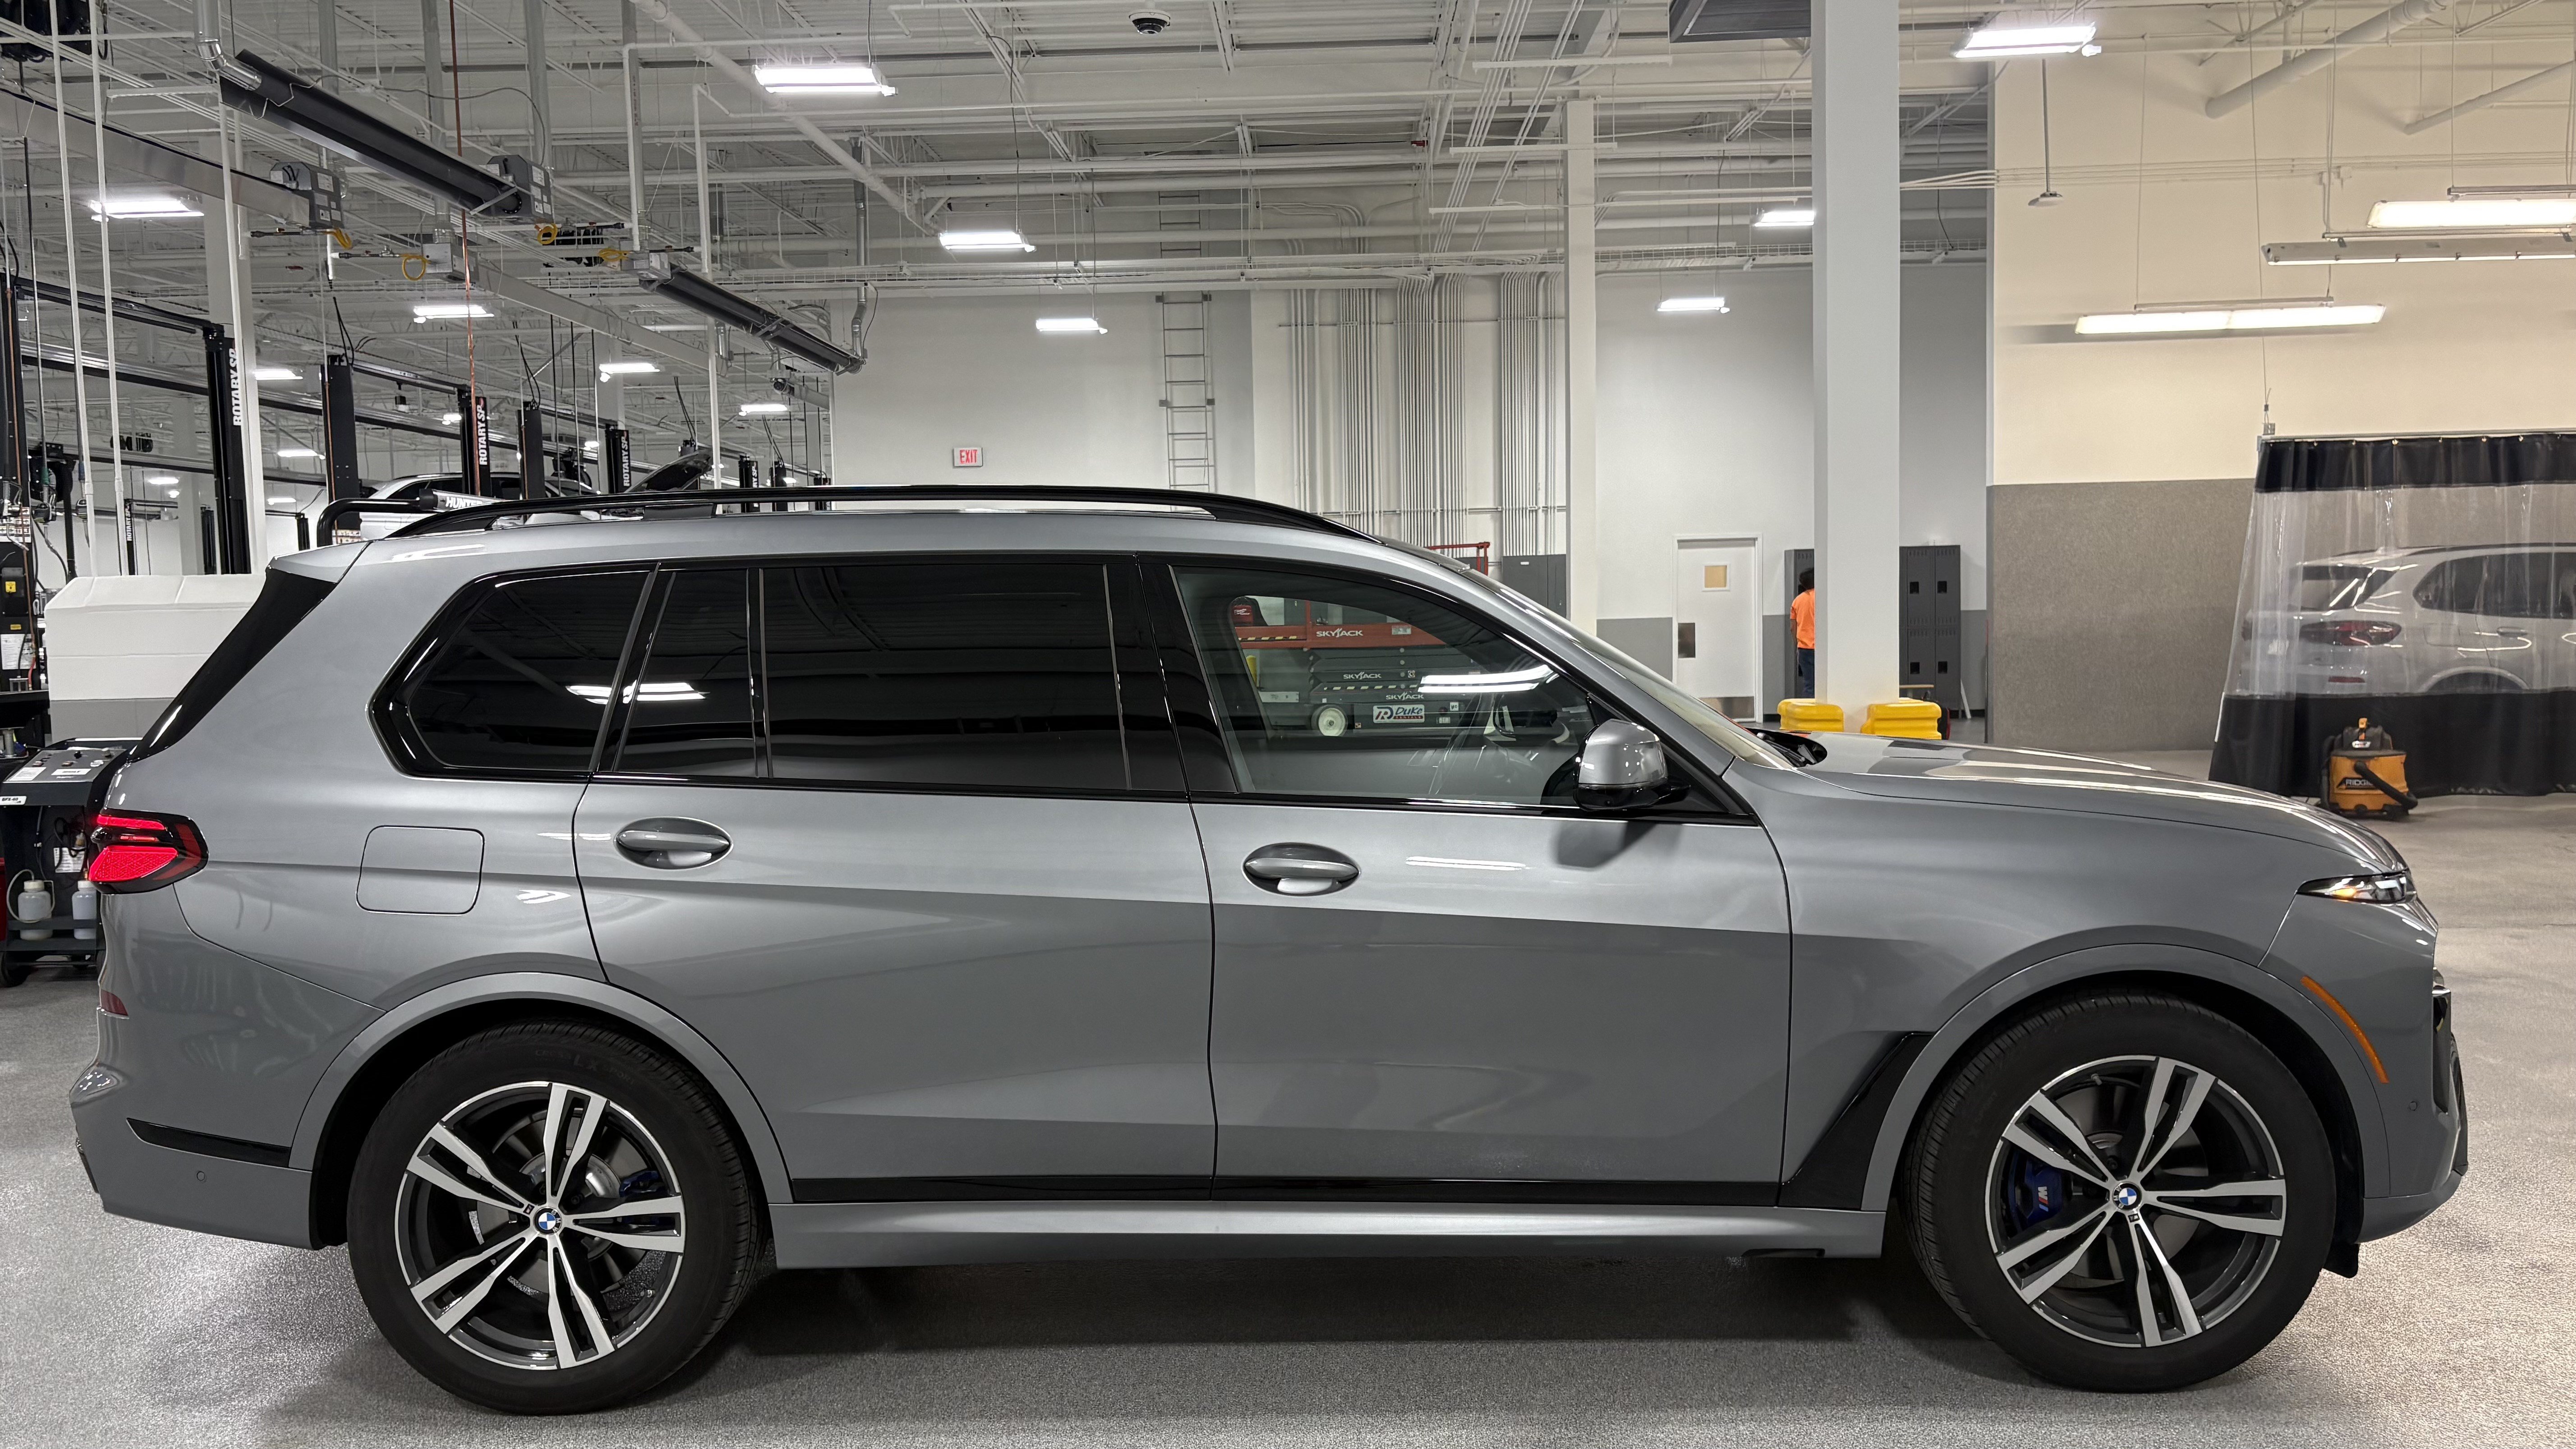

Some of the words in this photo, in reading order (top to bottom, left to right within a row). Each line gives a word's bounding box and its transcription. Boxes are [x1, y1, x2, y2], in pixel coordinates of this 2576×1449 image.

[230, 368, 242, 426] ROTARY
[477, 405, 486, 421] SP
[478, 421, 488, 465] ROTARY
[621, 436, 628, 450] SP
[960, 450, 977, 464] EXIT
[1316, 628, 1363, 638] SKYJACK
[1343, 672, 1381, 680] SKYJACK
[1386, 692, 1424, 700] SKYJACK
